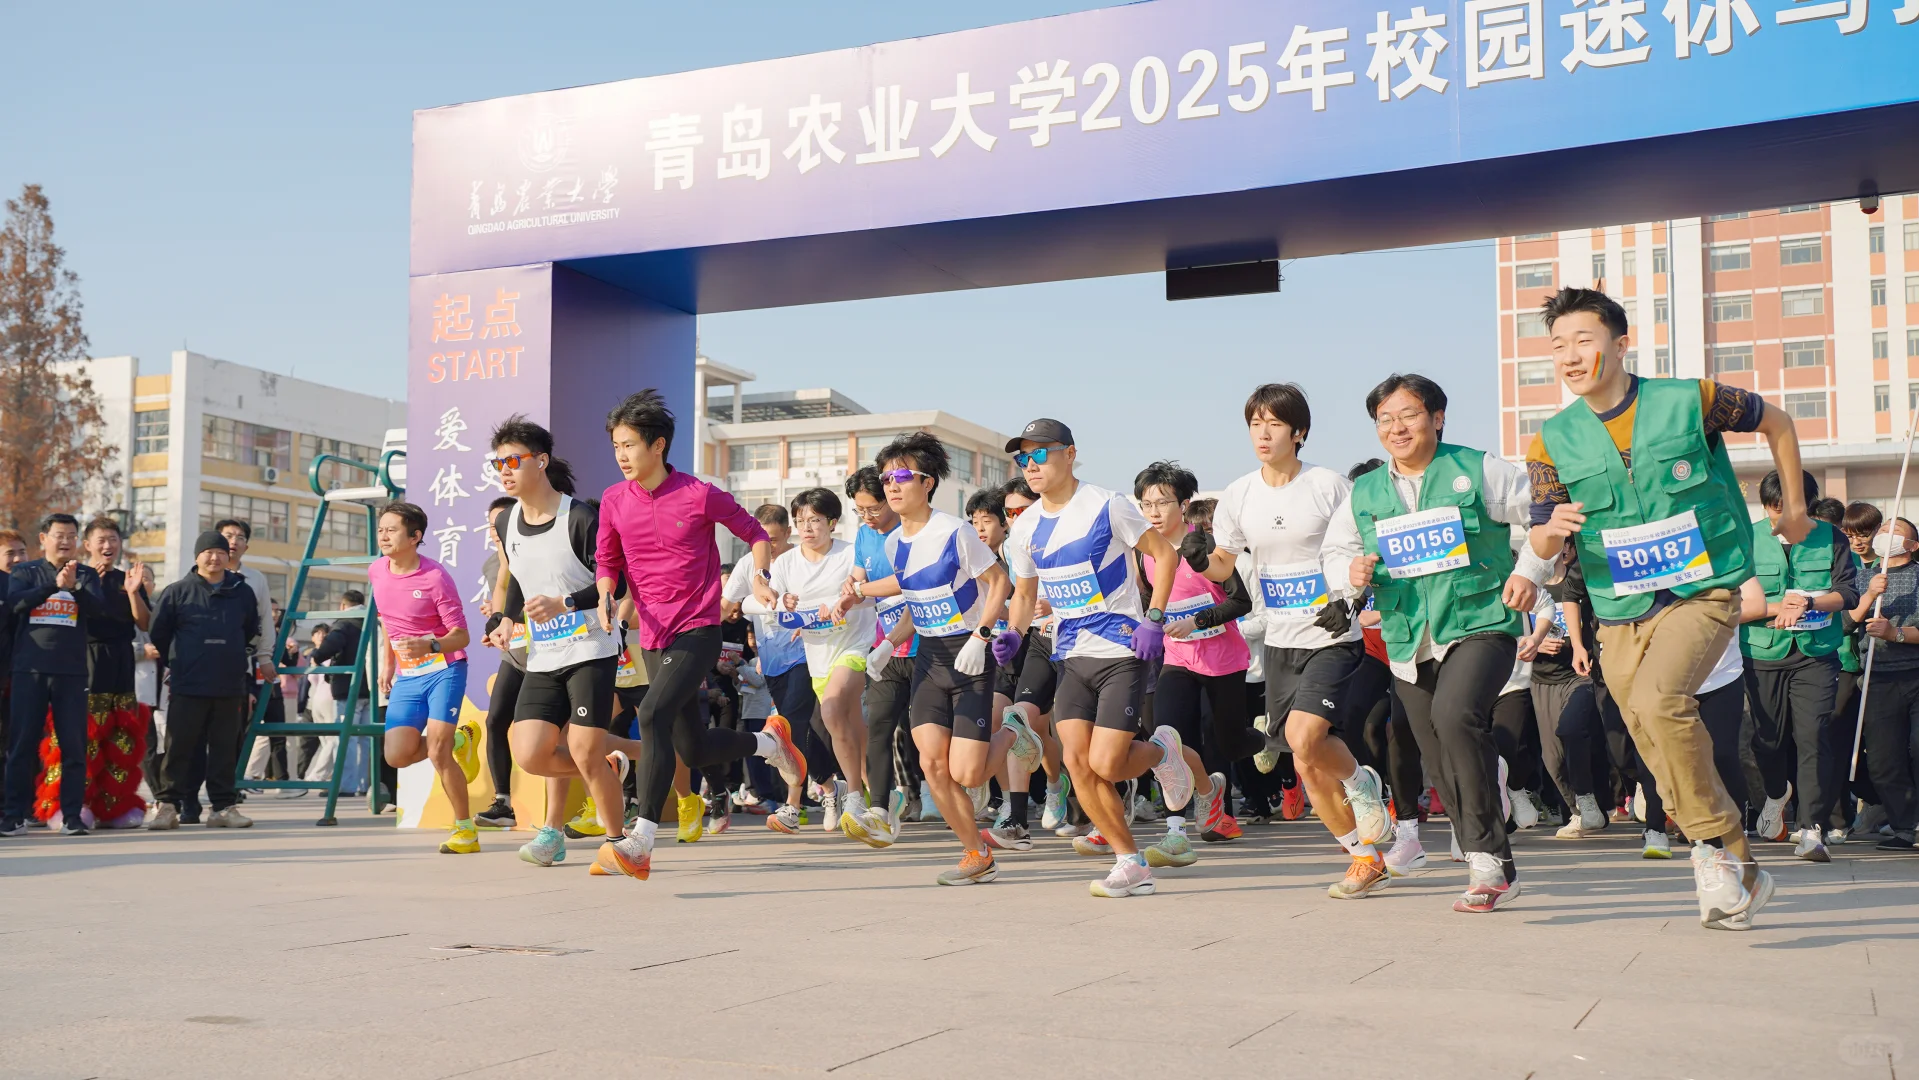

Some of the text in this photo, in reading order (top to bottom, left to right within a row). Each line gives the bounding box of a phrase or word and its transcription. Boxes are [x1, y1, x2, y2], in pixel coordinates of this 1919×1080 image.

[645, 0, 1919, 191] 青岛农业大学2025年校园迷你
[467, 208, 620, 235] QINGDAO AGRICULTURAL UNIVERSITY
[430, 286, 523, 343] 起点
[427, 346, 525, 383] START
[429, 406, 472, 567] 爱体育
[1387, 527, 1456, 556] B0156
[1617, 536, 1691, 569] B0187
[1046, 580, 1092, 599] B0308
[1266, 579, 1316, 598] B0247
[1628, 582, 1658, 591] 学生男子组
[911, 602, 952, 619] B0309
